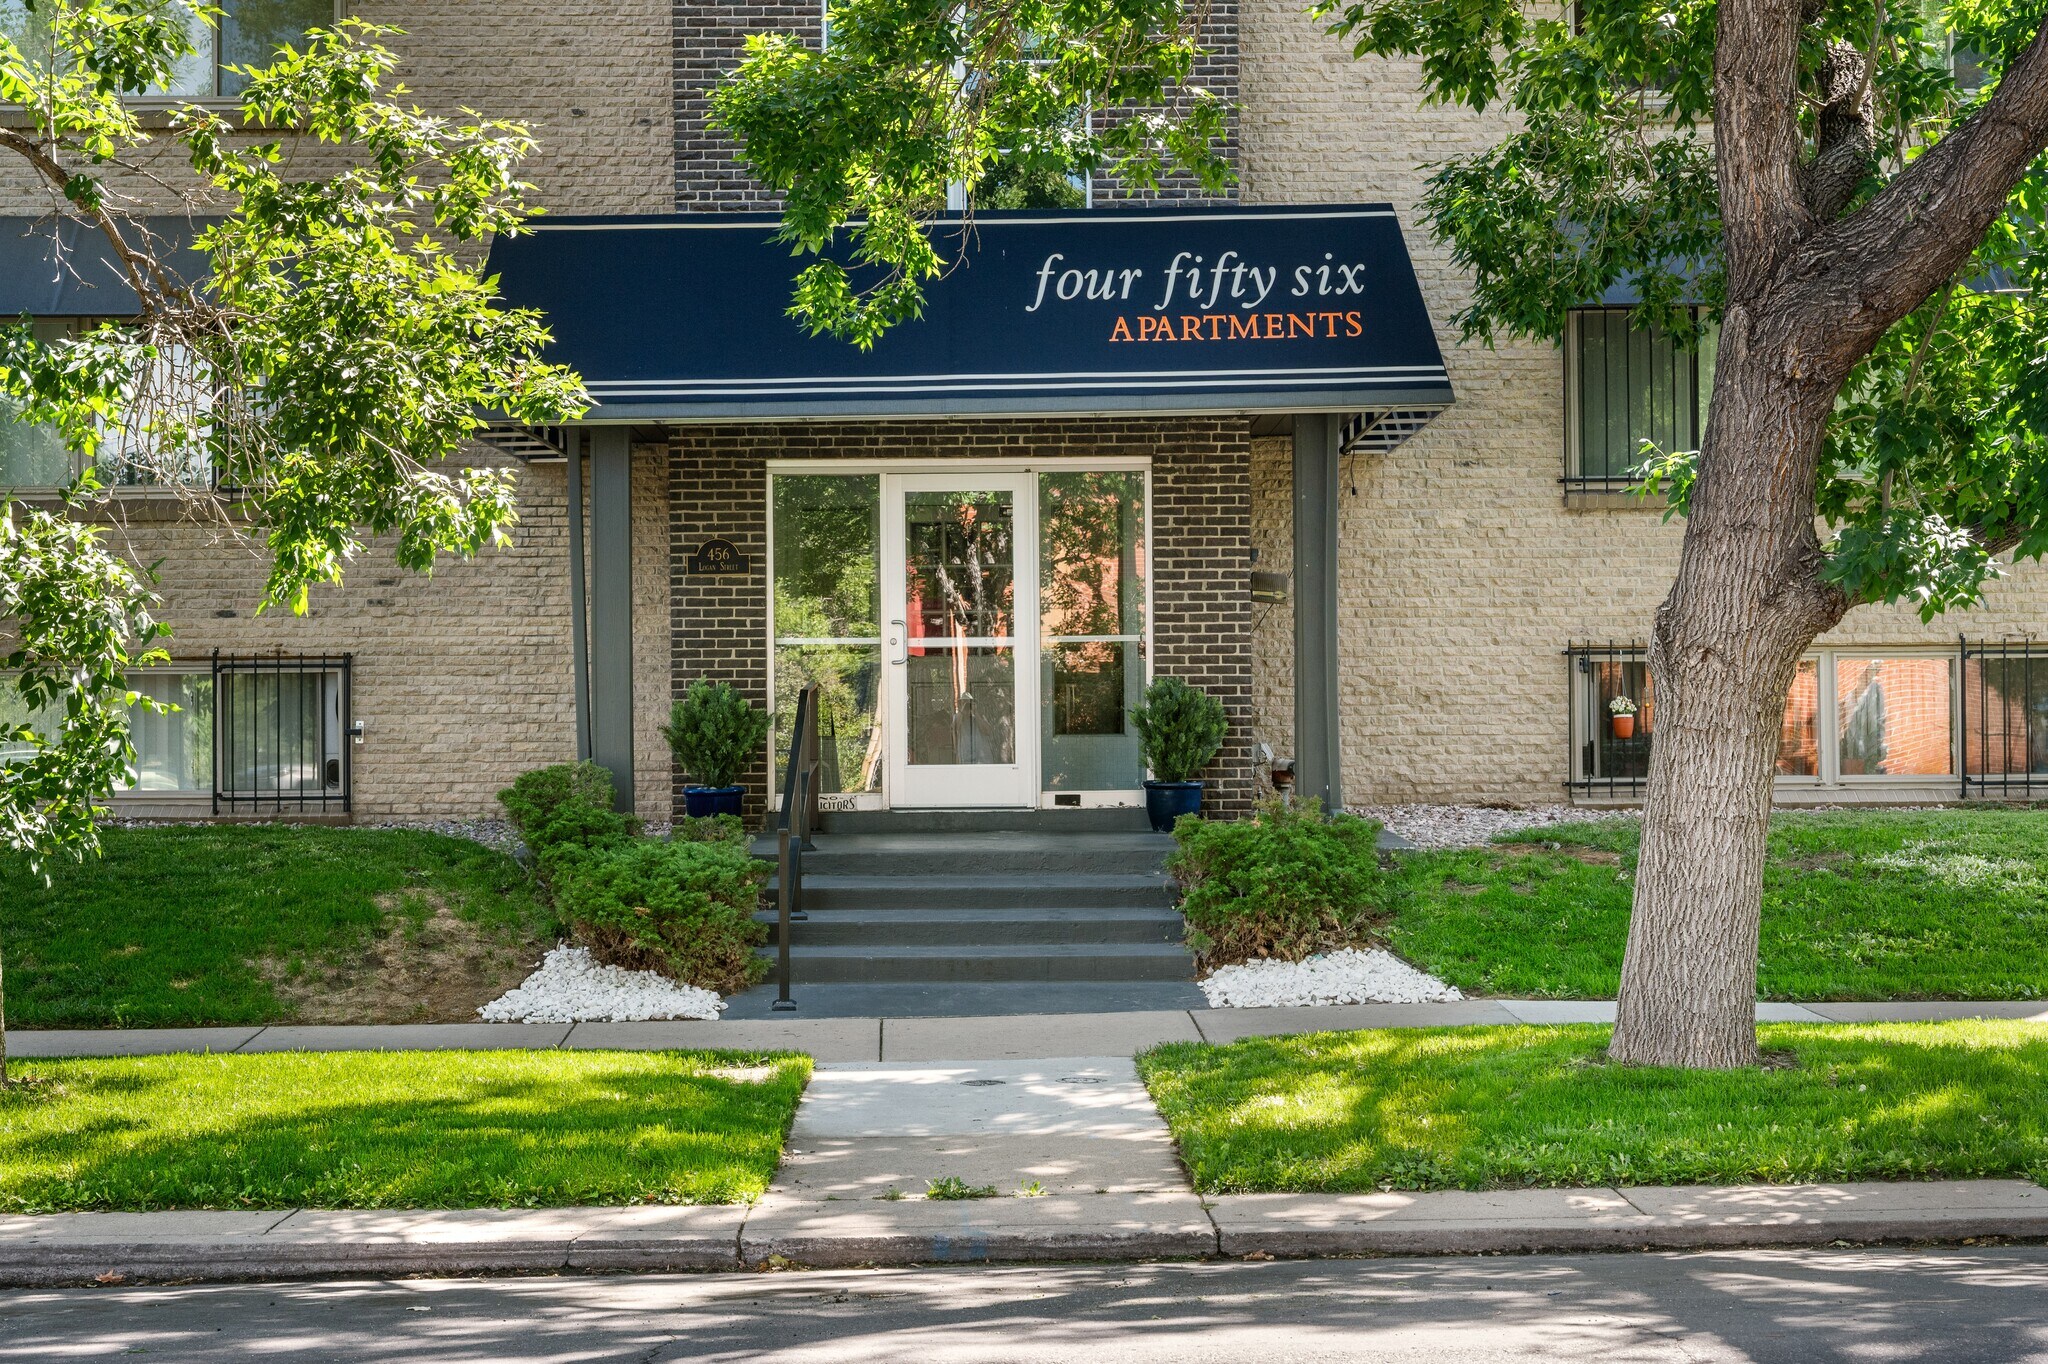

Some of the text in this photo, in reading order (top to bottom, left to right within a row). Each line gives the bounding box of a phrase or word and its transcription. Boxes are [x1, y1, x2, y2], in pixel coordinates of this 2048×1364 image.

[1025, 251, 1365, 312] four fifty six
[1109, 311, 1363, 342] APARTMENTS
[707, 547, 730, 561] 456
[820, 797, 855, 810] ICITORS
